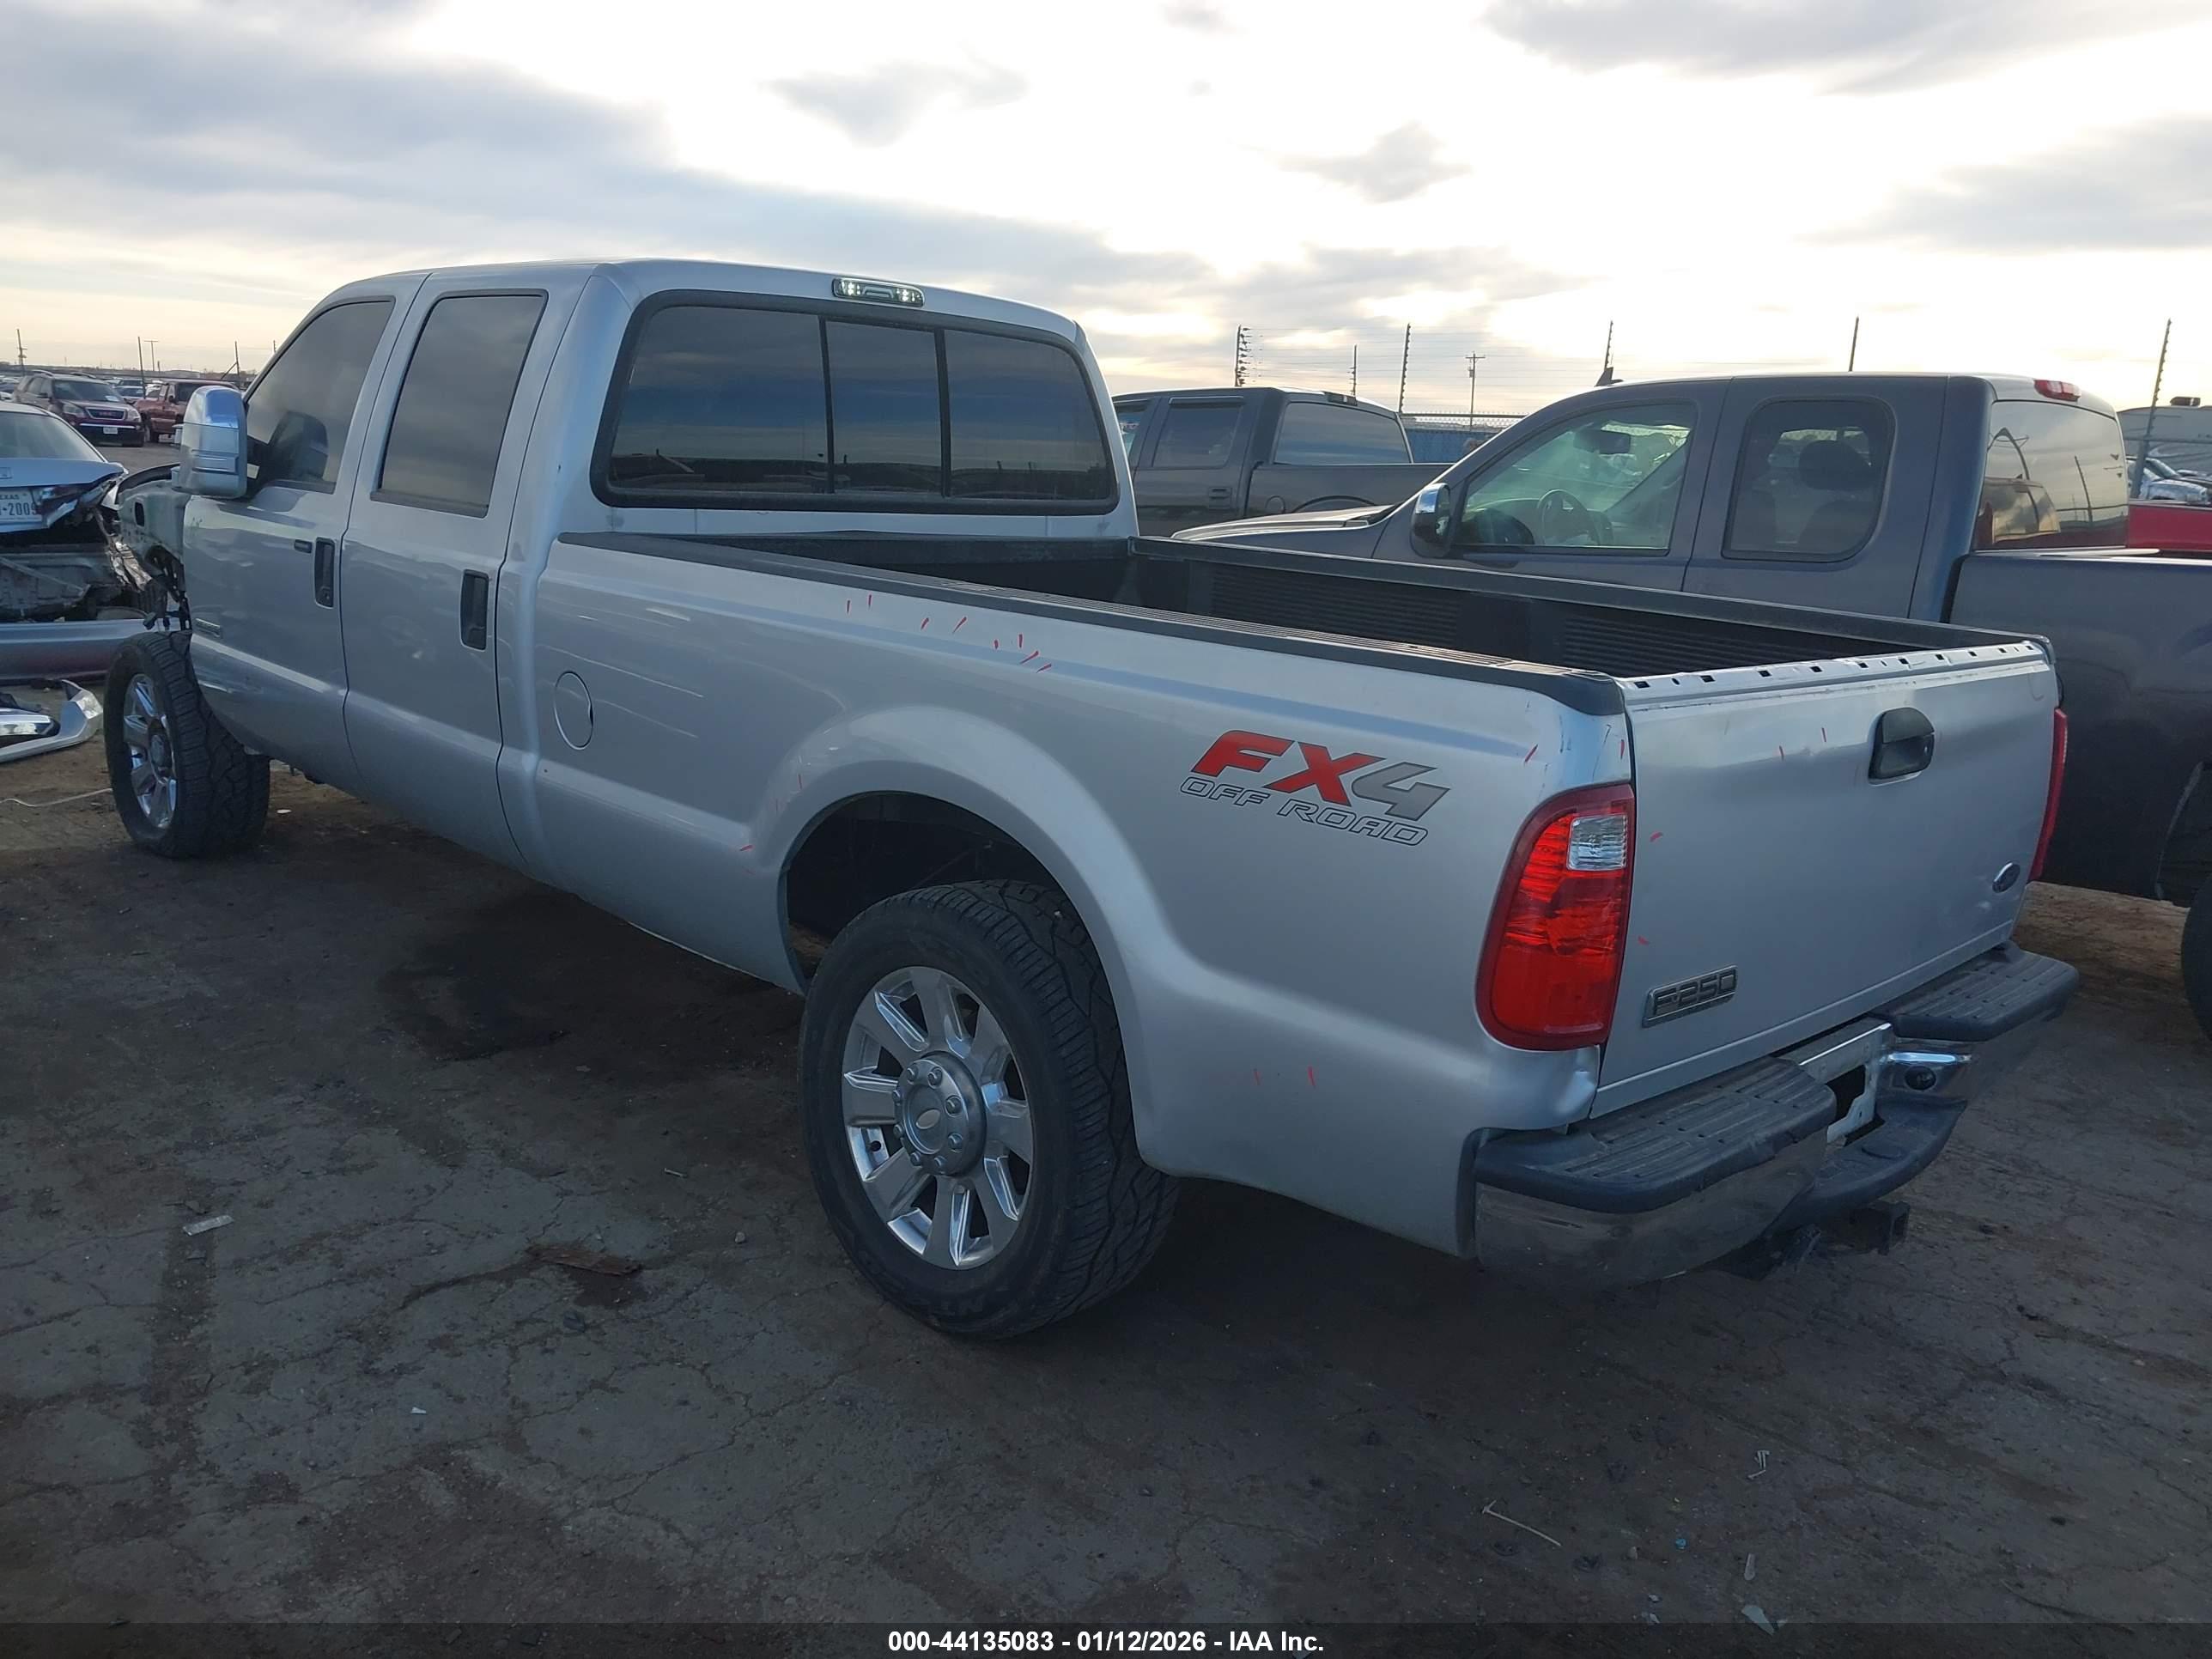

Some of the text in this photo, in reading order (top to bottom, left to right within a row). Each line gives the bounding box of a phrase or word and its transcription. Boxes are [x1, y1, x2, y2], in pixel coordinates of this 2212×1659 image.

[1179, 775, 1429, 847] OFF ROAD
[1190, 729, 1450, 821] FX4
